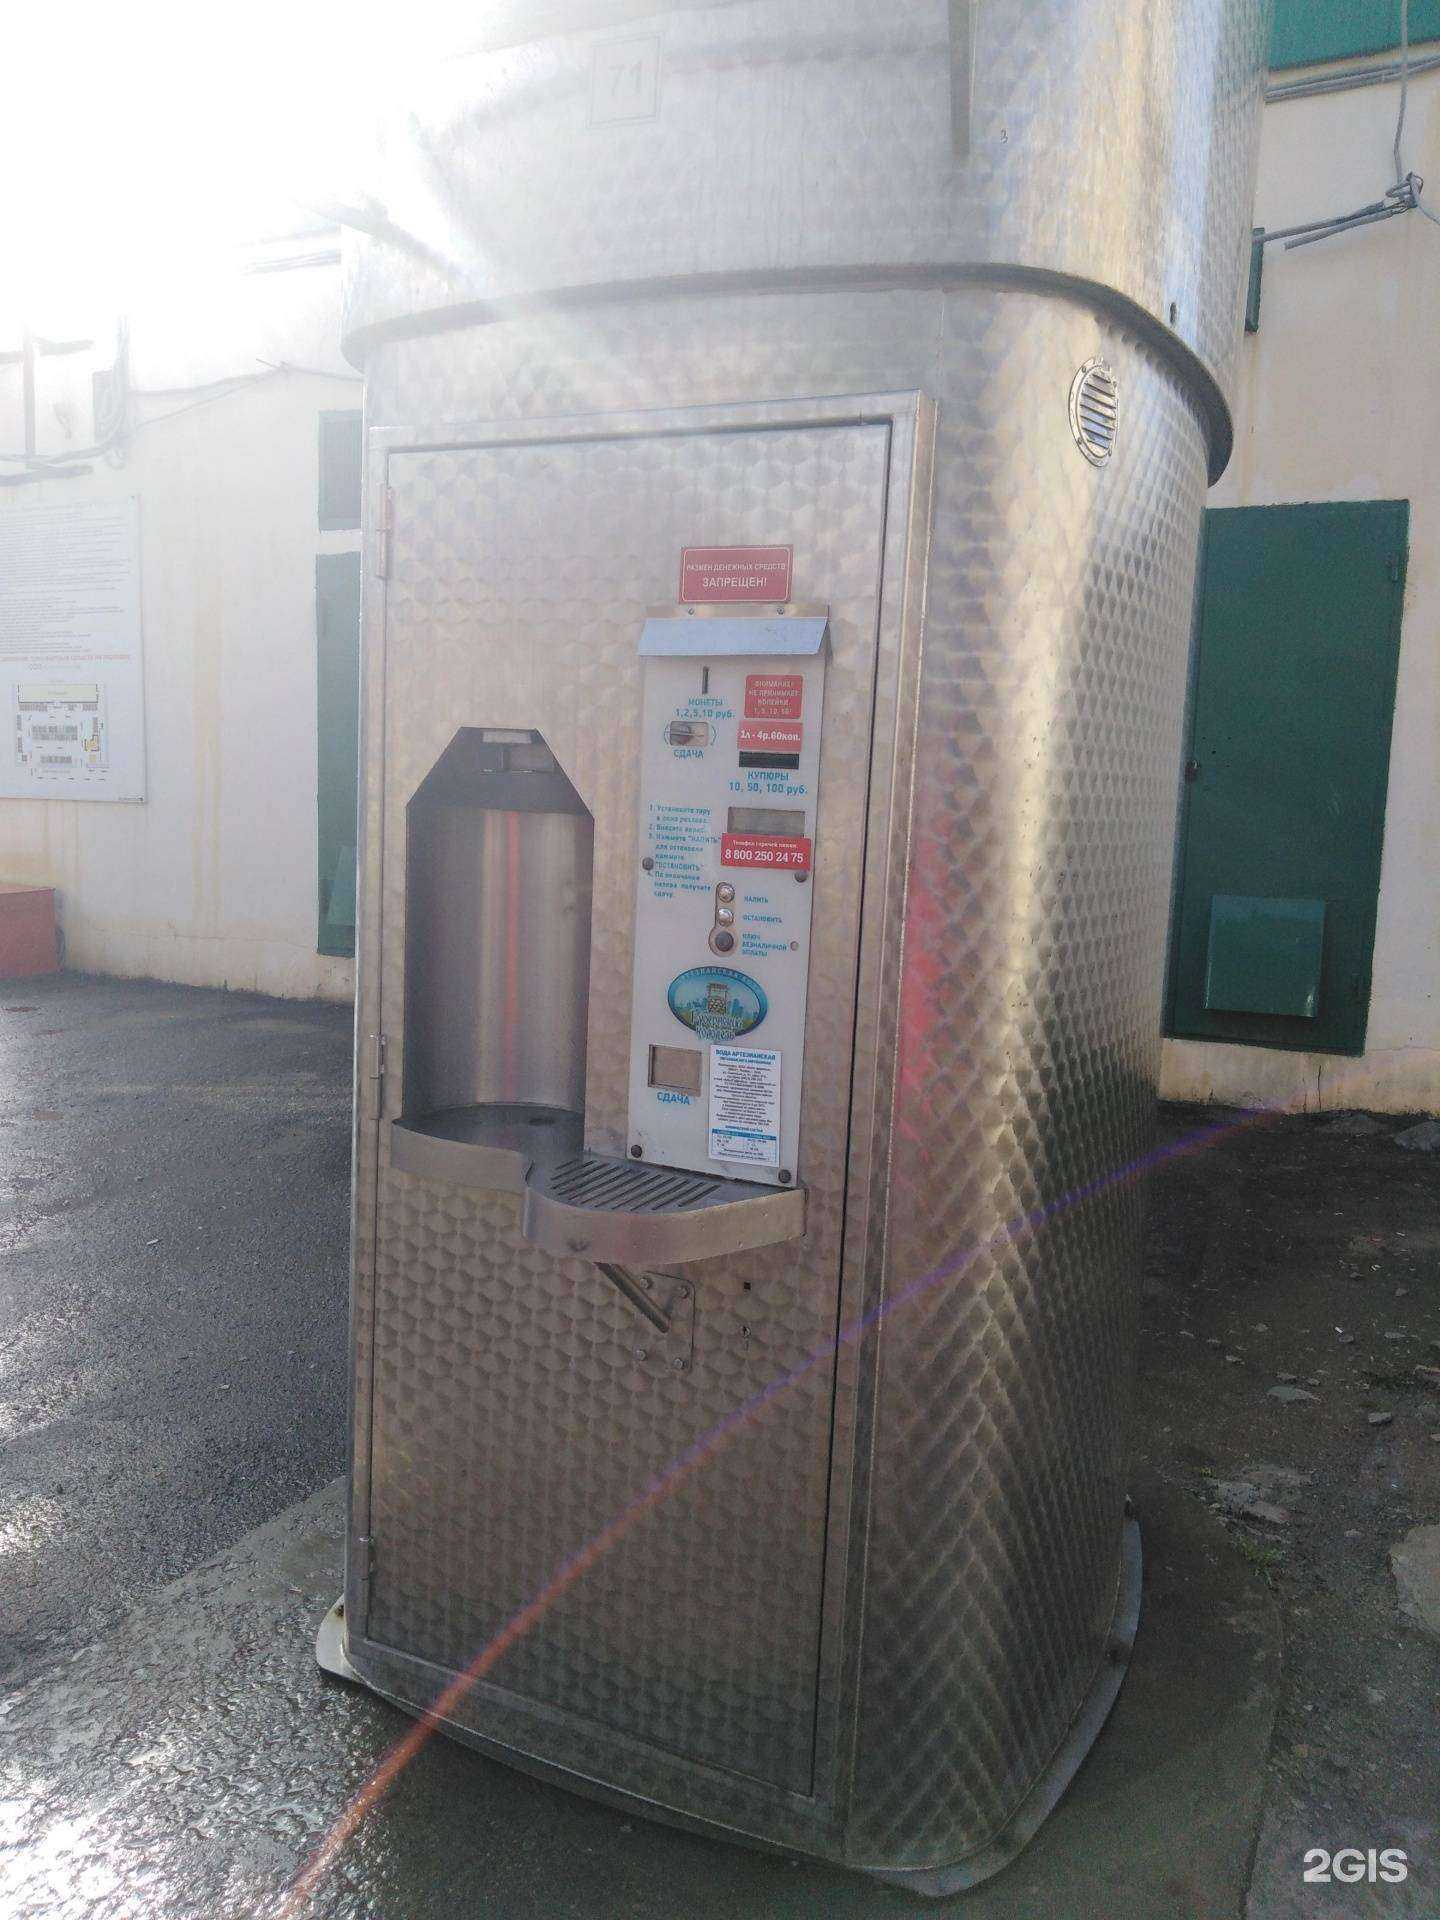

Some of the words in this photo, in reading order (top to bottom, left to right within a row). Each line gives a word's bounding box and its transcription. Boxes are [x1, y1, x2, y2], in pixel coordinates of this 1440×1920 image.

[702, 577, 767, 588] ЗАПРЕЩЕН!
[688, 698, 723, 706] МОНЕТЫ
[715, 710, 736, 719] руб.
[674, 749, 704, 759] СДАЧА
[748, 770, 789, 781] КУПЮРЫ
[729, 781, 744, 793] 10,
[747, 782, 762, 794] 50,
[766, 783, 784, 793] 100
[786, 784, 808, 796] руб.
[725, 848, 732, 859] 8
[733, 849, 752, 860] 800
[755, 850, 773, 862] 250
[776, 851, 788, 863] 24
[791, 852, 803, 863] 75
[656, 1091, 690, 1104] СДАЧА
